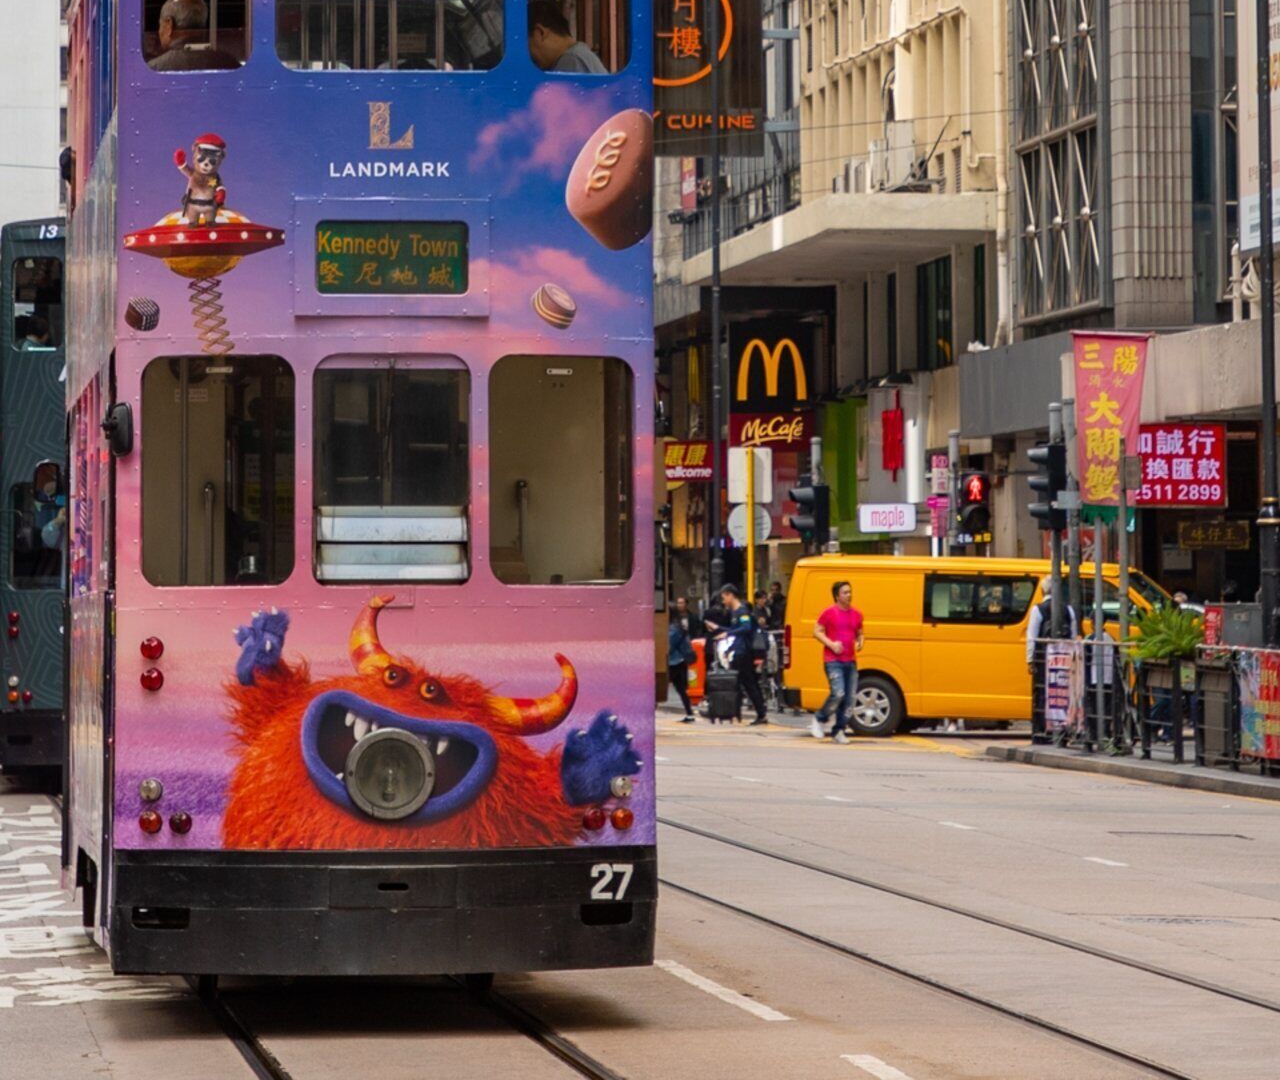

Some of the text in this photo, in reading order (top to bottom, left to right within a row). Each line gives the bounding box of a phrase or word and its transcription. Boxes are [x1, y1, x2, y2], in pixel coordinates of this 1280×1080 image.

[329, 162, 450, 178] LANDMARK
[39, 224, 59, 239] 13
[317, 231, 458, 260] Kennedy Town
[1079, 343, 1139, 376] 三陽
[740, 415, 804, 447] McCafé
[1138, 458, 1221, 482] 換匯款
[1177, 483, 1221, 501] 2899
[871, 506, 905, 528] maple
[589, 863, 633, 901] 27
